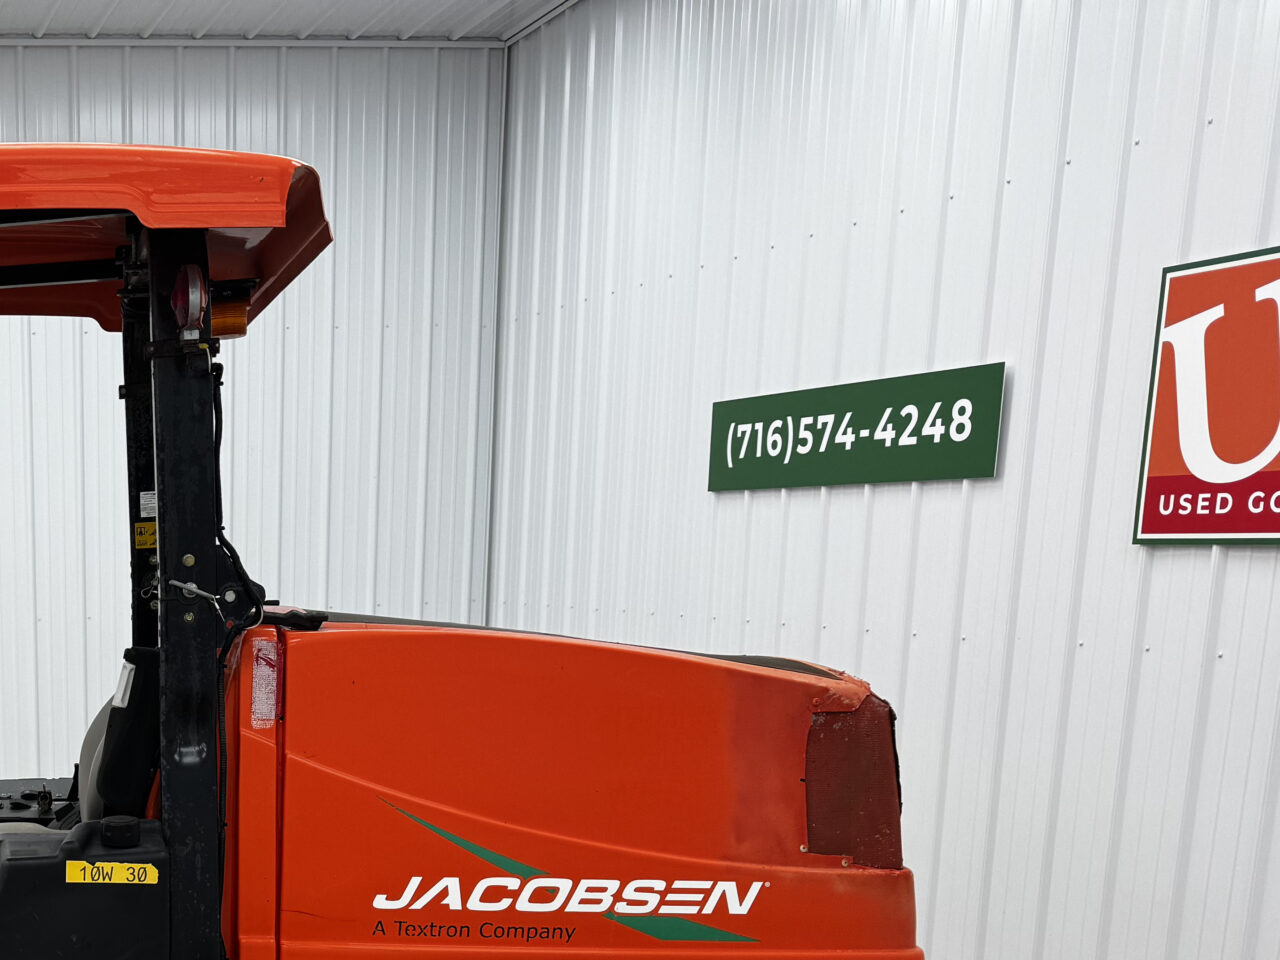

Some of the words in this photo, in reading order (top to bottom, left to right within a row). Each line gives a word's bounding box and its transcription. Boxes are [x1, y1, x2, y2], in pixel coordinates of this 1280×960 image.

[726, 399, 973, 468] (716)574-4248
[1159, 493, 1232, 515] USED
[80, 866, 114, 882] 10W
[126, 866, 148, 883] 30
[373, 877, 763, 914] JACOBSEN
[373, 921, 385, 935] A
[395, 921, 470, 937] Textron
[480, 923, 576, 943] Company
